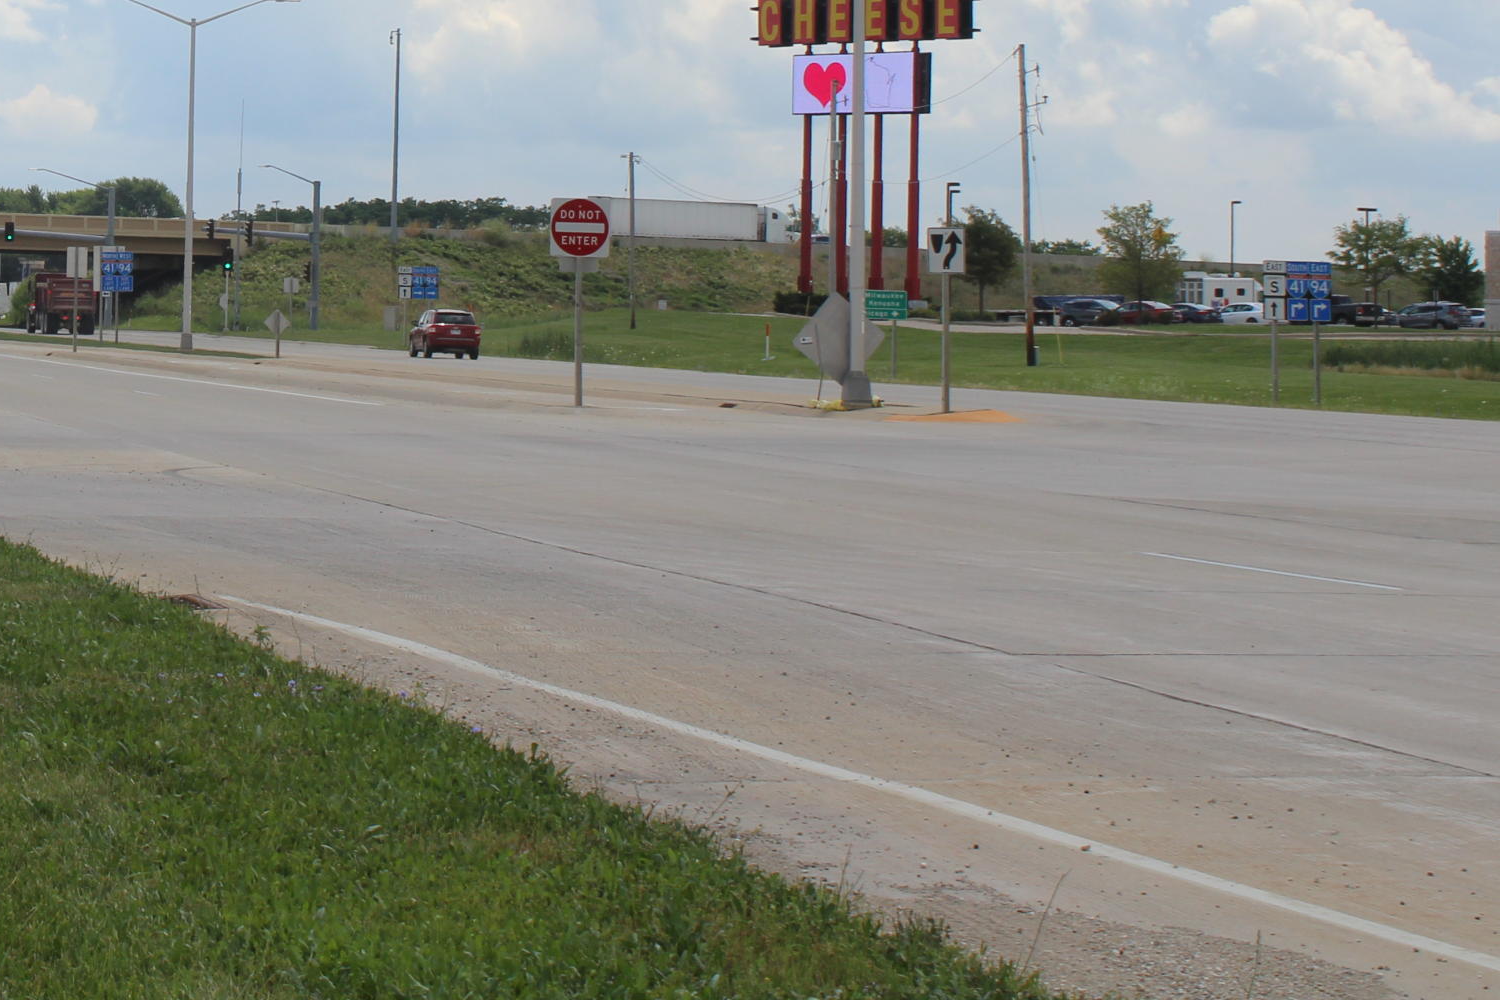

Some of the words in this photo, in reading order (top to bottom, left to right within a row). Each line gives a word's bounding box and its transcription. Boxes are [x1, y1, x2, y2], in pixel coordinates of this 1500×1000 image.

[560, 210, 575, 219] DO
[578, 210, 601, 220] NOT
[561, 235, 598, 246] ENTER
[104, 263, 114, 273] 41
[119, 263, 131, 273] 94
[1266, 263, 1282, 271] EAST
[1287, 263, 1308, 272] SOUTH
[1311, 264, 1328, 272] EAST
[1270, 281, 1279, 293] S
[1290, 281, 1304, 294] 41
[1311, 281, 1328, 294] 94
